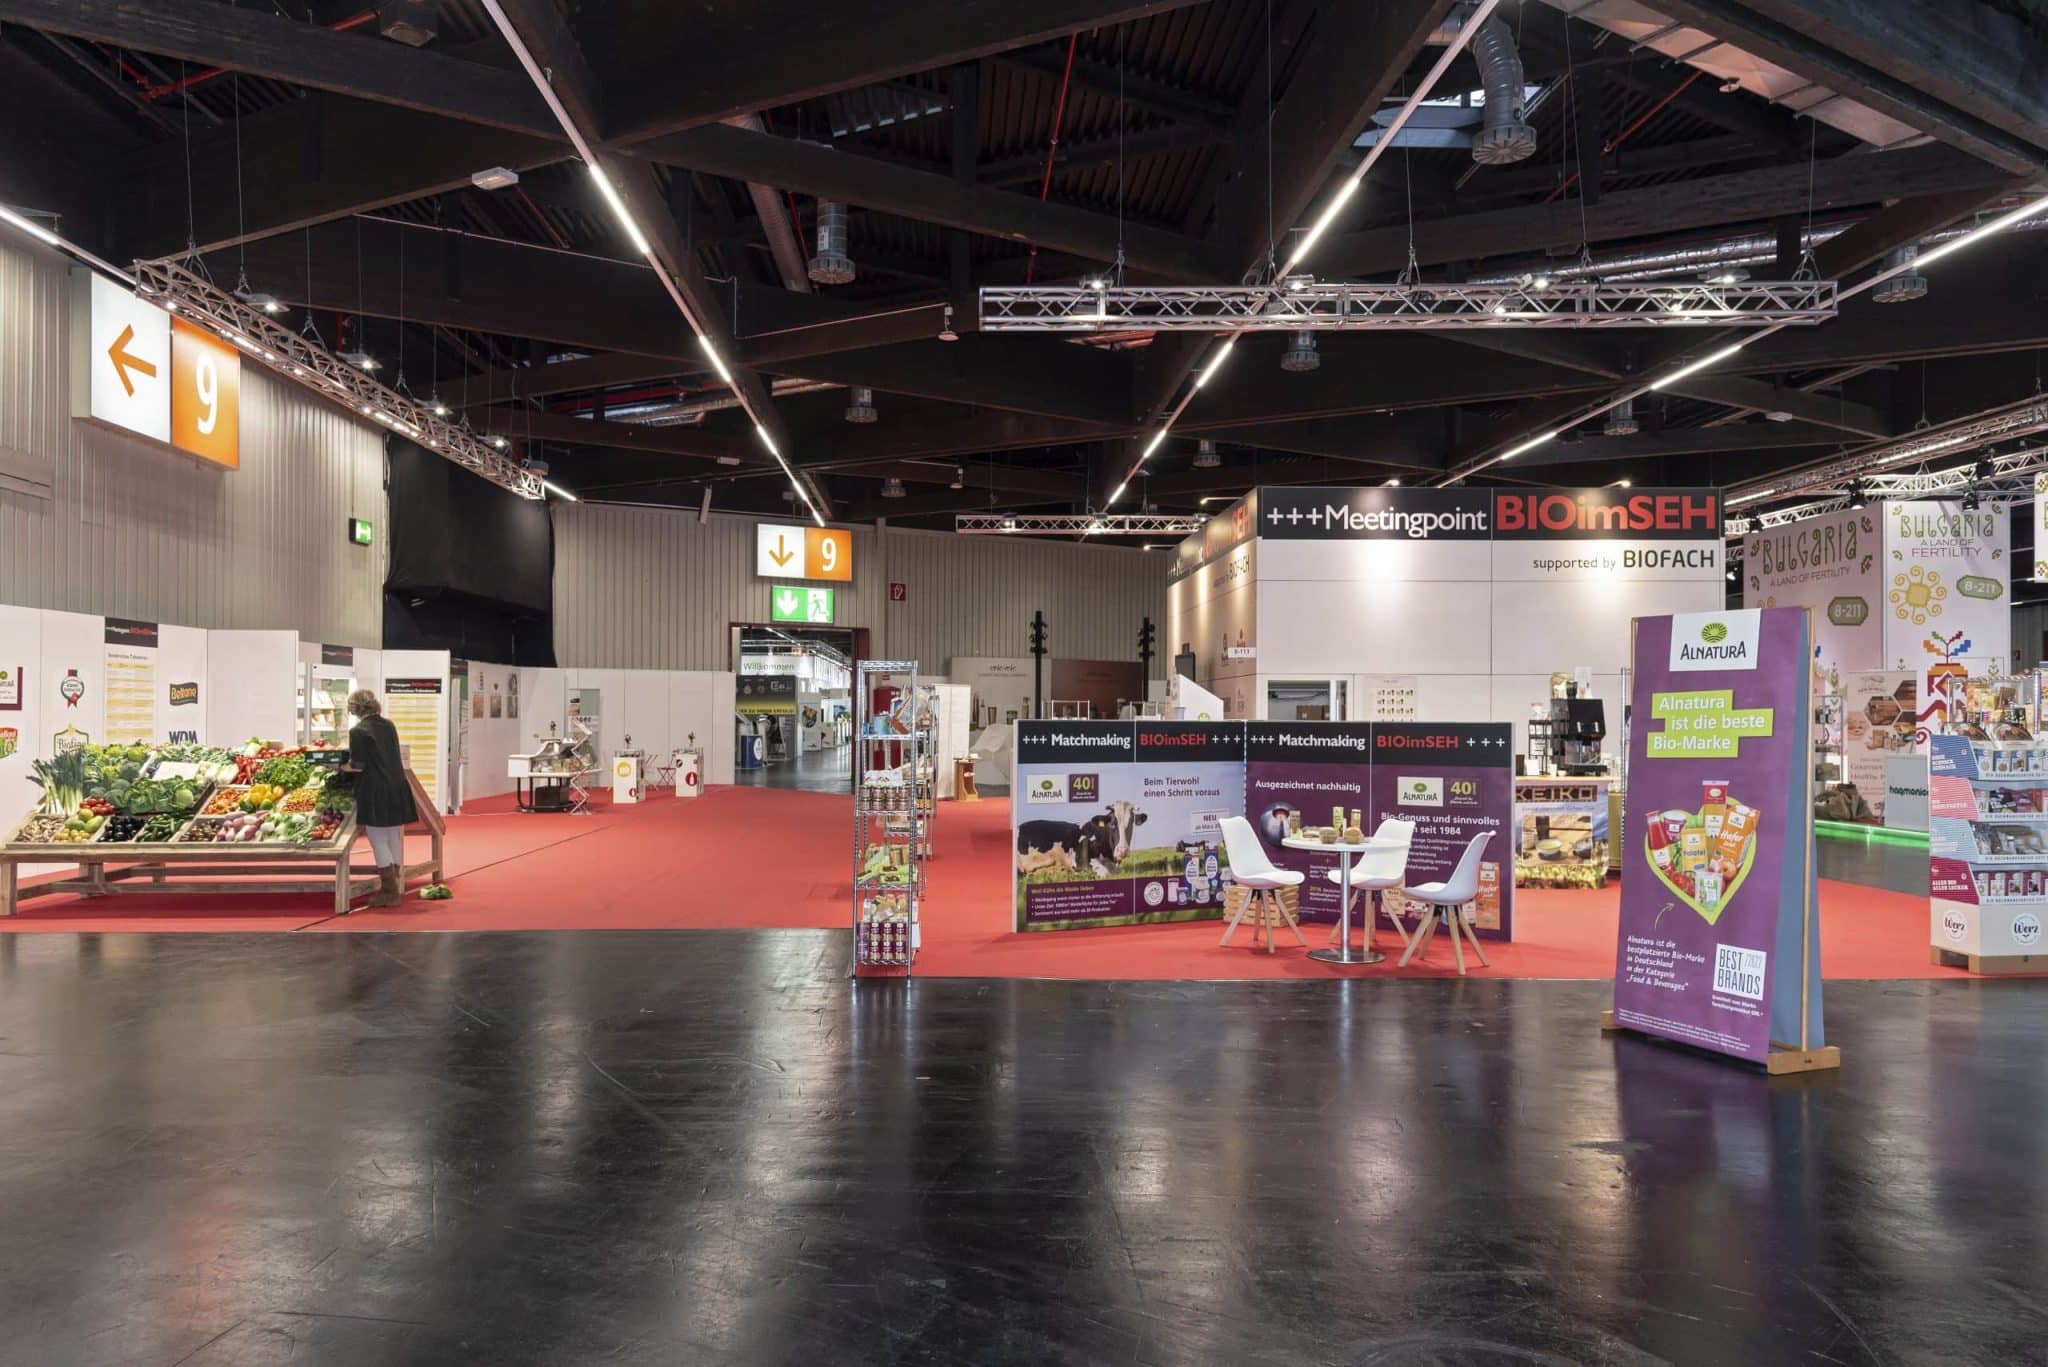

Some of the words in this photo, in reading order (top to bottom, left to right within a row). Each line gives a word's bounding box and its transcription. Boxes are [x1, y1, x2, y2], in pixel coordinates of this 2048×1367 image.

[195, 351, 218, 435] 9
[1496, 495, 1716, 531] BIOimSEH
[1920, 539, 1928, 547] A
[1930, 539, 1956, 547] LAND
[1960, 538, 1975, 546] OF
[821, 537, 838, 572] 9
[1533, 556, 1599, 571] supported
[1603, 556, 1617, 571] by
[1623, 549, 1715, 569] BIOFACH
[1911, 547, 1983, 558] FERTILITY
[1777, 575, 1798, 587] LAND
[1800, 573, 1810, 583] OF
[1811, 567, 1850, 581] FERTILITY
[1680, 640, 1747, 660] ALNATURA
[743, 663, 795, 671] Willkommen
[1659, 696, 1725, 711] Alnatura
[1672, 715, 1689, 730] ist
[1694, 714, 1717, 729] die
[1722, 713, 1765, 729] beste
[1051, 733, 1131, 750] Matchmaking
[1140, 733, 1207, 746] BIOimSEH
[1279, 734, 1366, 751] Matchmaking
[1376, 735, 1459, 749] BIOimSEH
[1653, 735, 1732, 750] Bio-Marke
[1144, 777, 1164, 786] Beim
[1166, 776, 1200, 786] Tierwohl
[1256, 779, 1314, 790] Ausgezeichnet
[1316, 782, 1361, 793] nachhaltig
[1144, 789, 1166, 798] einen
[1168, 788, 1193, 797] Schritt
[1195, 789, 1221, 797] voraus
[1203, 814, 1217, 822] NEU
[1432, 814, 1451, 824] und
[1453, 815, 1501, 826] sinnvolles
[1420, 826, 1438, 835] seit
[1440, 826, 1462, 836] 1984
[1719, 948, 1744, 972] BEST
[1717, 967, 1761, 995] BRANDS
